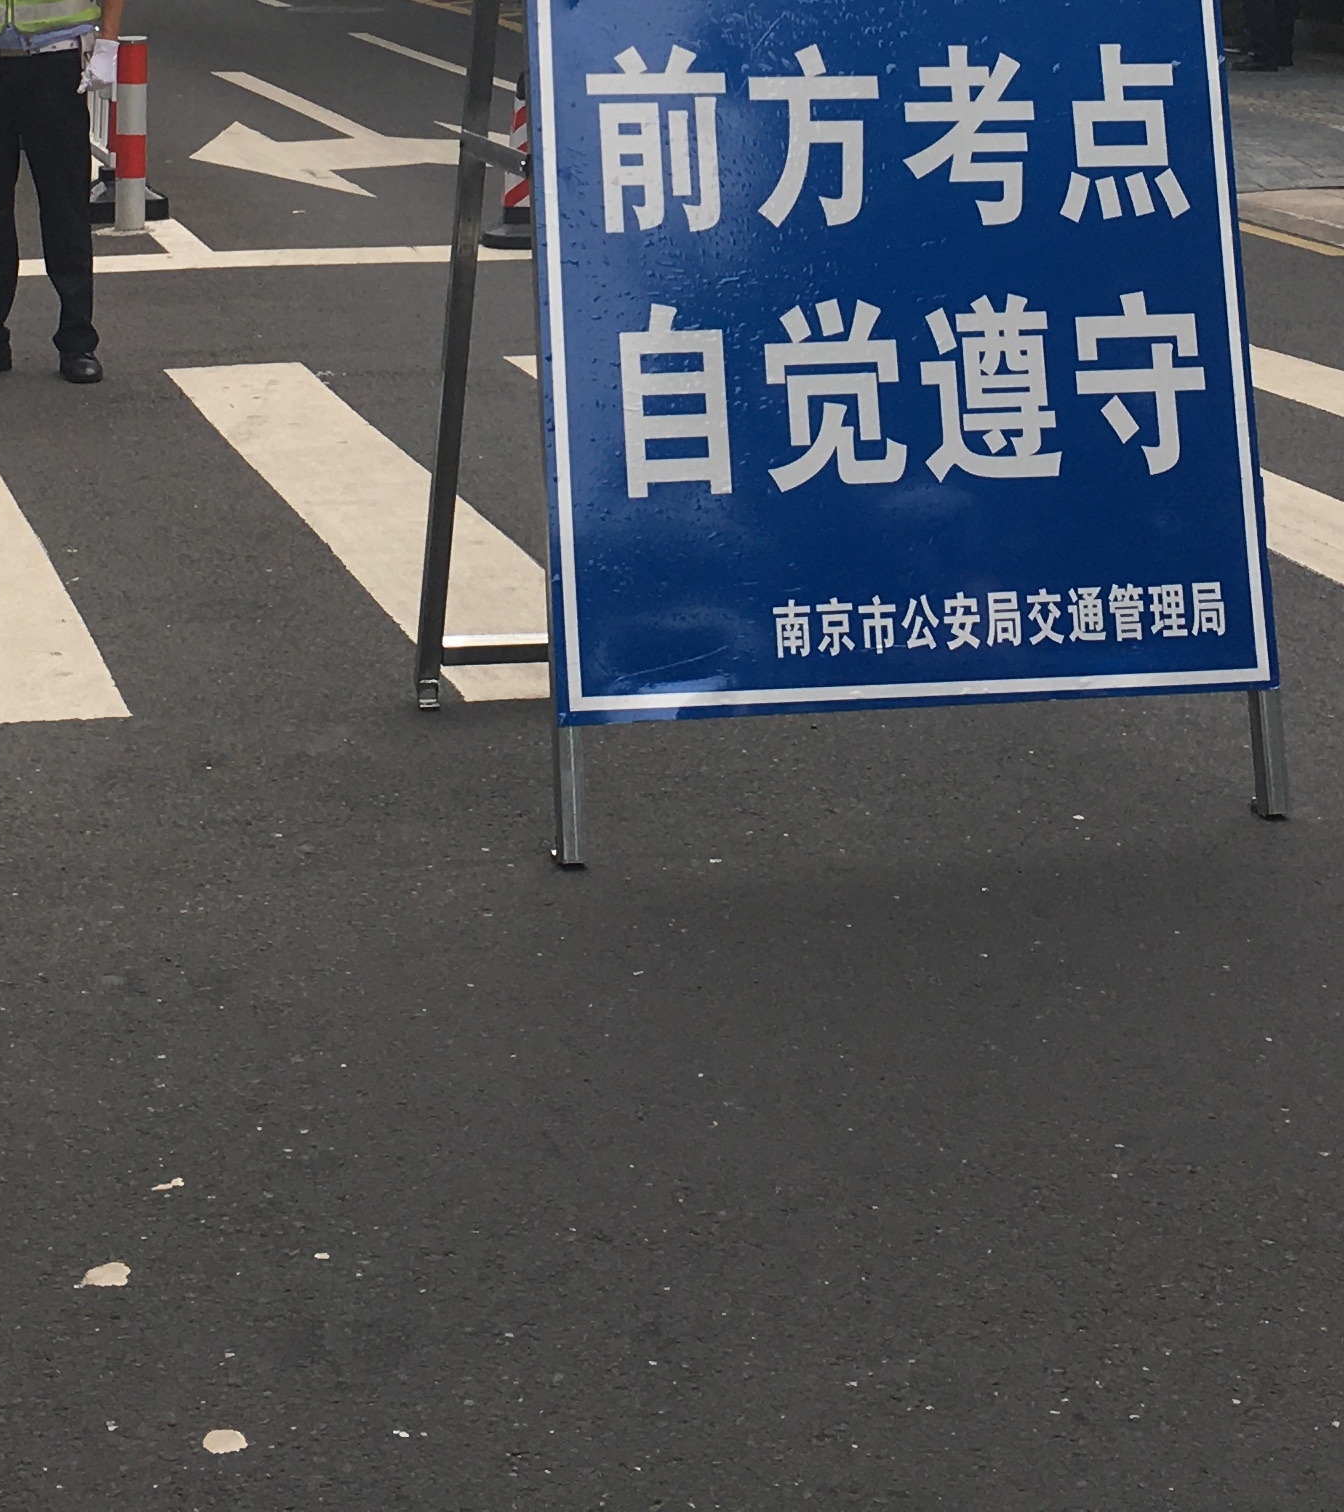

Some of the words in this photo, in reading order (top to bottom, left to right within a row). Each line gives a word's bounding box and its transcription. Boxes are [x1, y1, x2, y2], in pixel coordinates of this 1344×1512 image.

[585, 43, 1190, 234] 前方考点
[617, 291, 1207, 499] 自觉遵守
[771, 581, 1227, 659] 南京市公安局交通管理局
